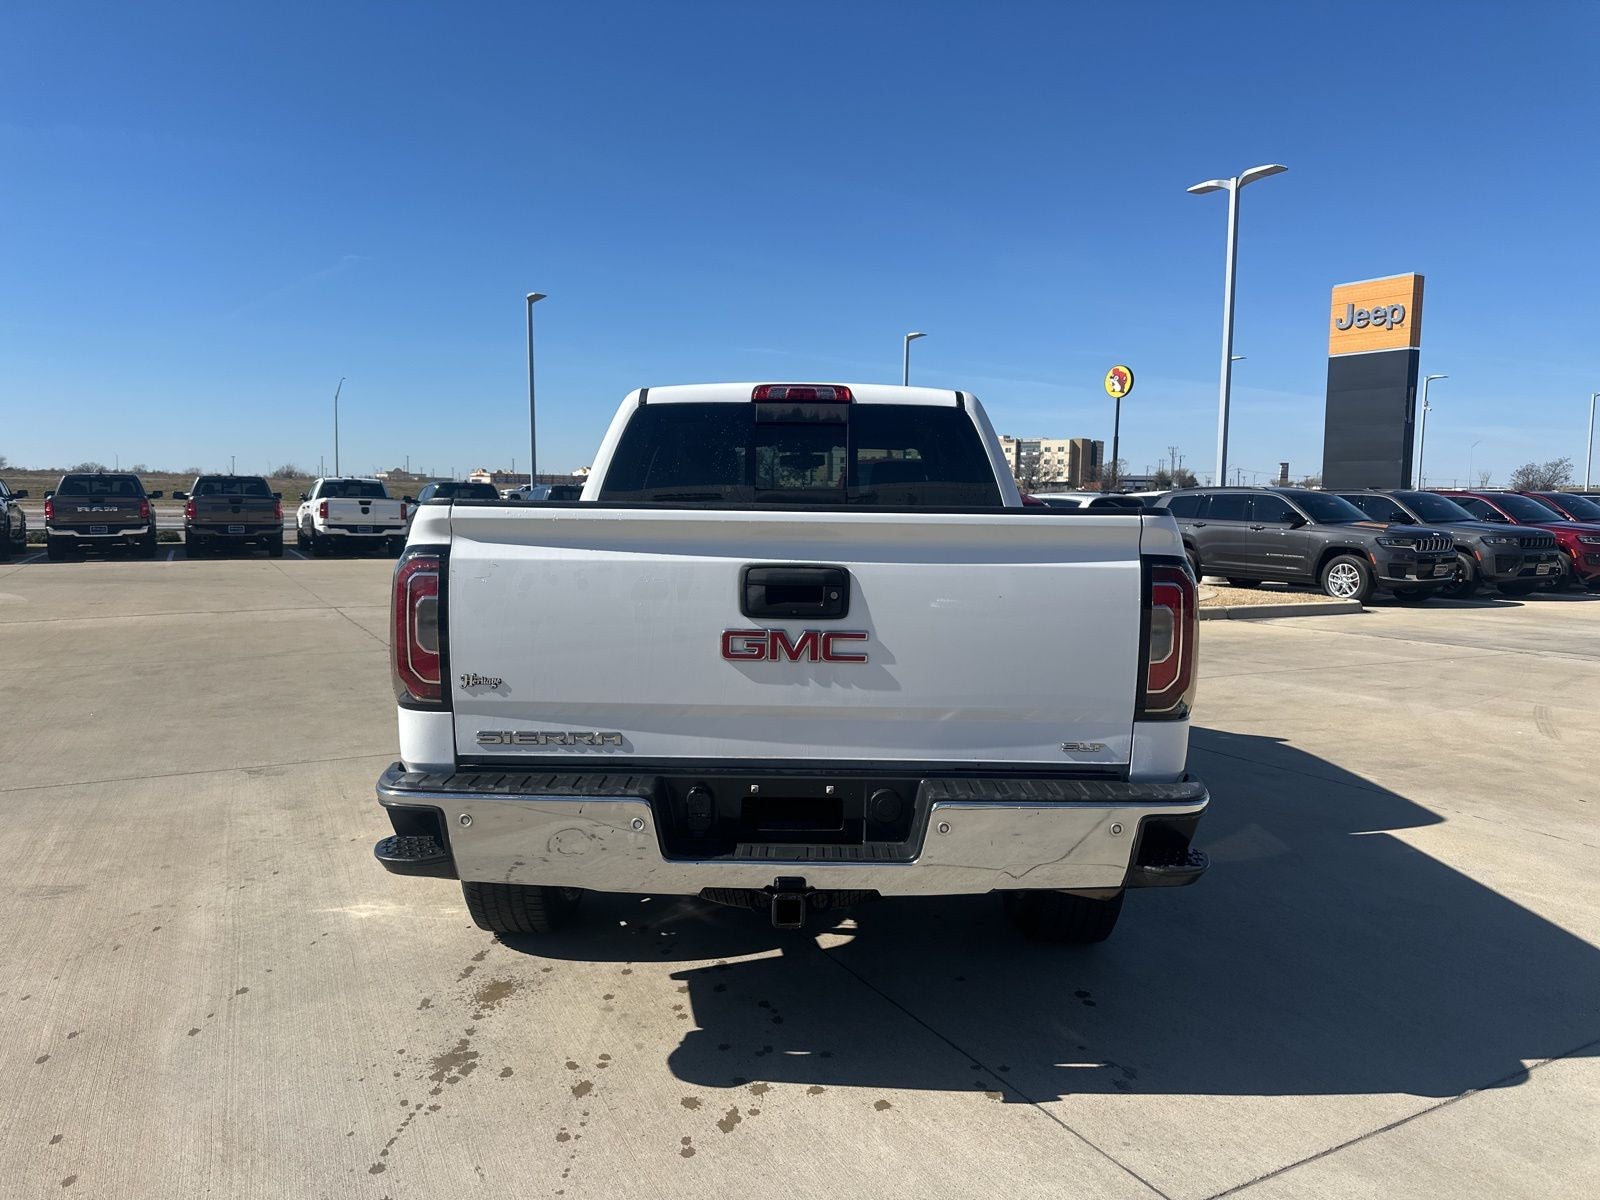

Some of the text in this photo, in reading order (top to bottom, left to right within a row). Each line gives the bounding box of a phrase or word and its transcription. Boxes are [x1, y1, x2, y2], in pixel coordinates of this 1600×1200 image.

[1336, 304, 1405, 330] Jeep
[720, 629, 869, 663] GMC
[460, 673, 502, 689] Heritage
[476, 731, 623, 746] SIERRA
[1061, 742, 1104, 753] SLT
